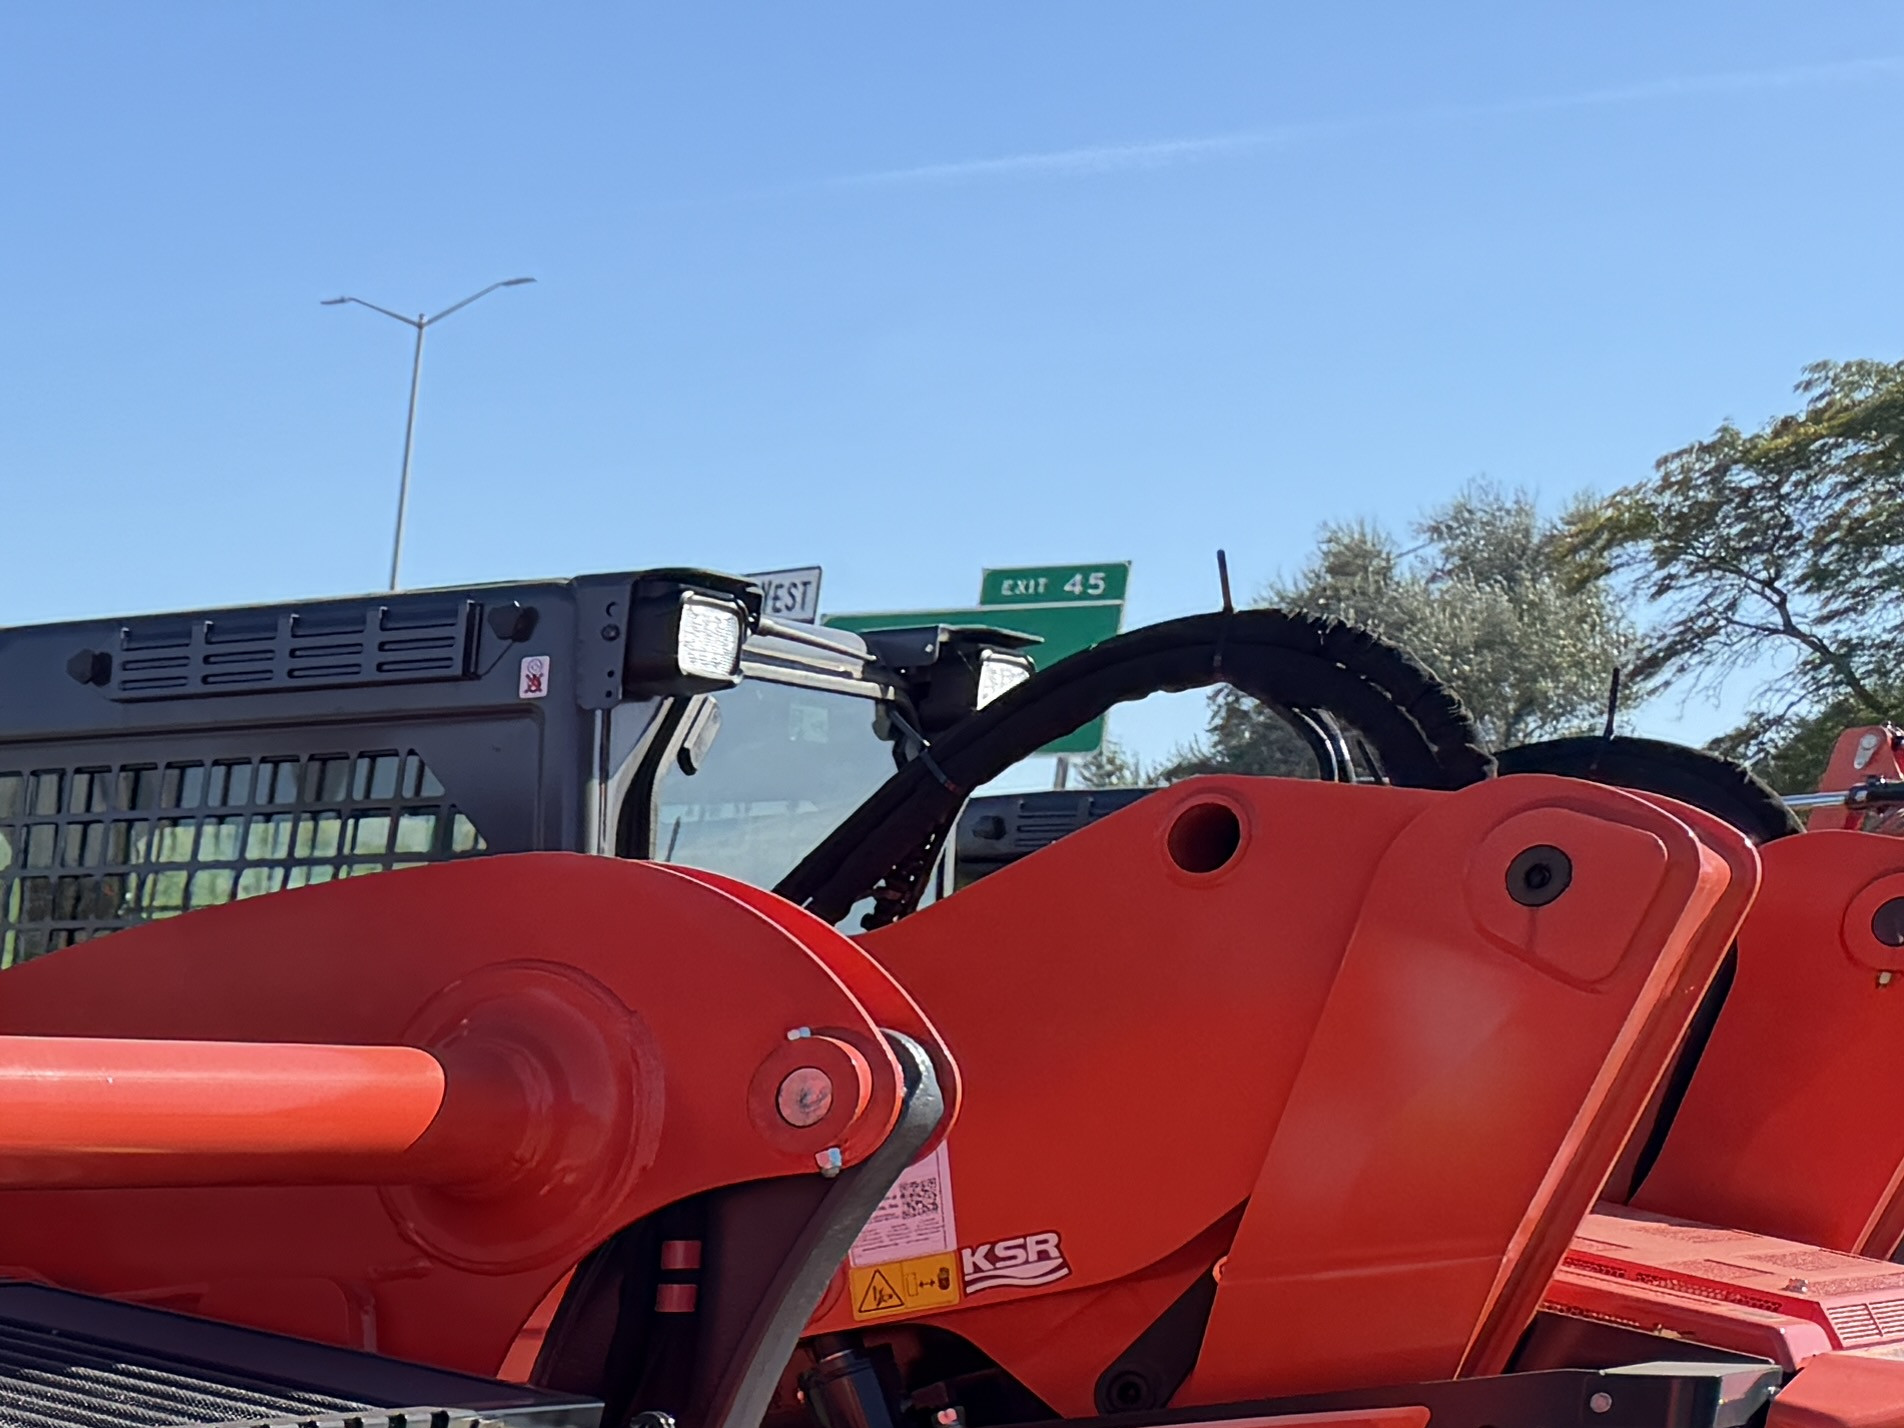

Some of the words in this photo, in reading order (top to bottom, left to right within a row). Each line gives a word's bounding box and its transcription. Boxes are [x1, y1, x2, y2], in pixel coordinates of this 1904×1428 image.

[1000, 577, 1049, 596] EXIT
[1062, 572, 1106, 596] 45
[961, 1232, 1062, 1276] KSR
